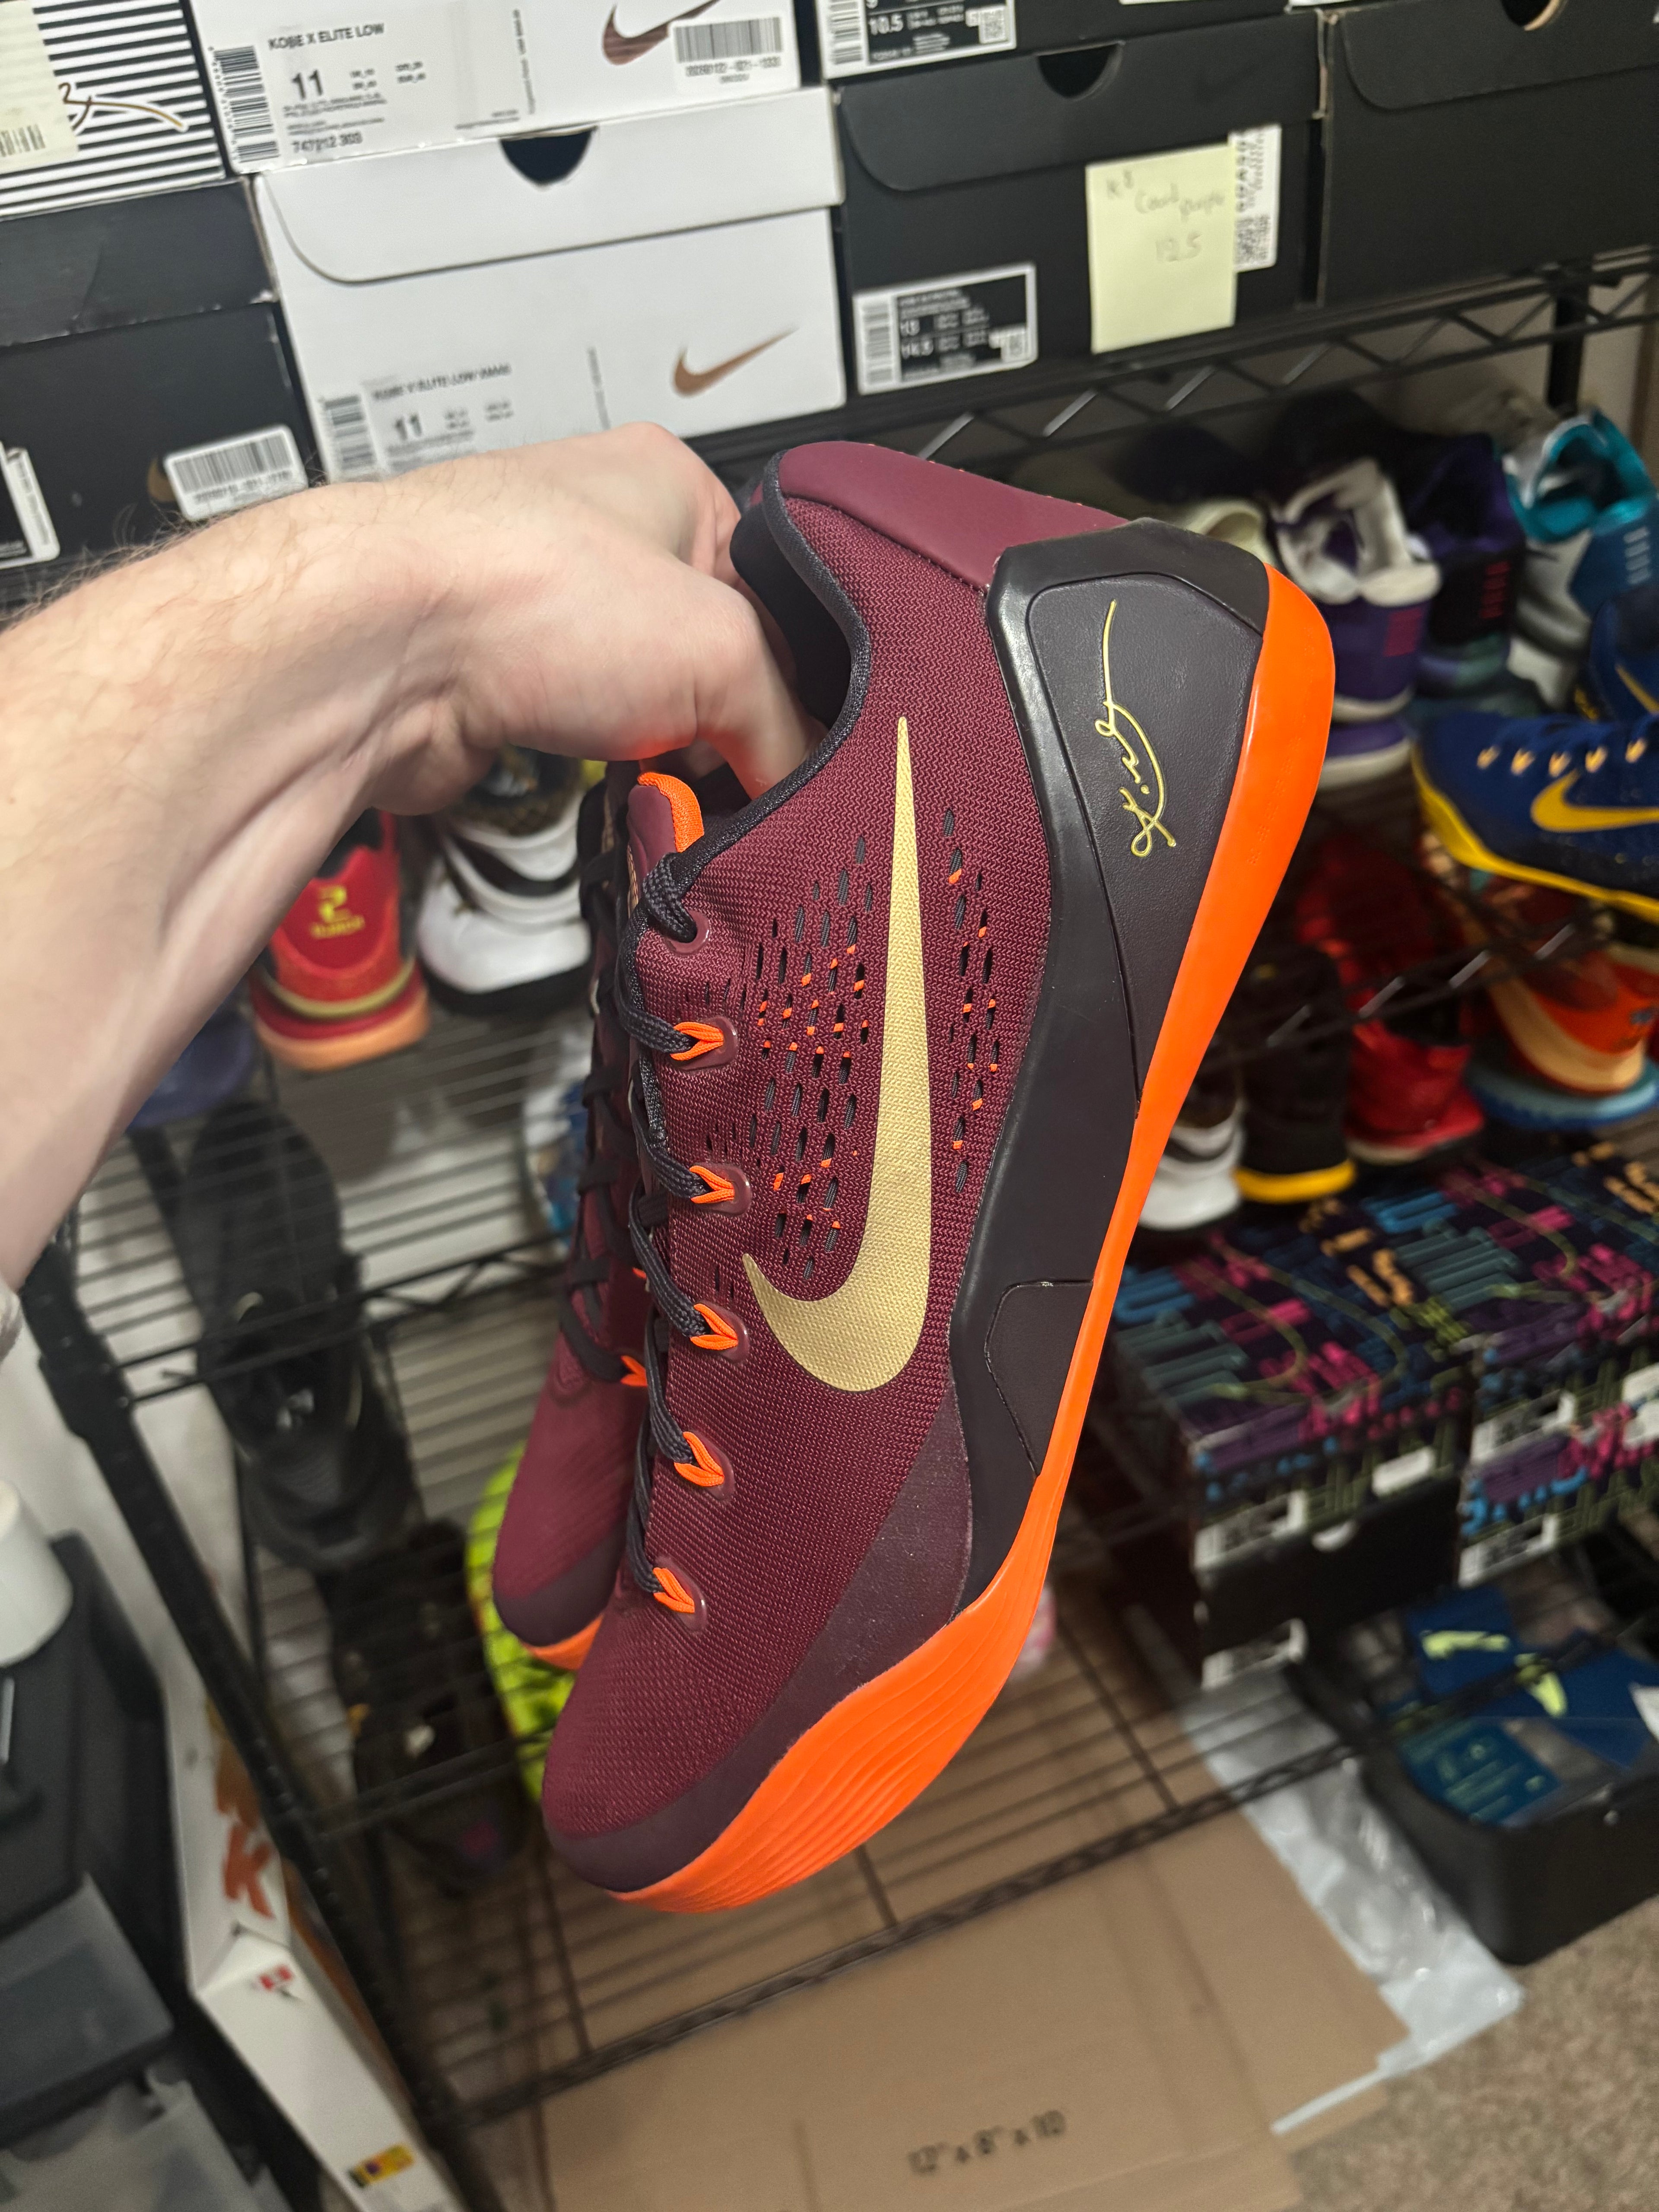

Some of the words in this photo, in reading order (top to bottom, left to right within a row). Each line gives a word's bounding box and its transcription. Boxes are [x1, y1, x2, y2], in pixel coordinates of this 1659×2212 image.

[268, 34, 305, 50] KOBE
[306, 32, 317, 45] X
[318, 26, 355, 44] ELITE
[356, 22, 385, 38] LOW
[868, 13, 904, 35] 10.5
[292, 69, 325, 100] 11
[393, 412, 423, 441] 11
